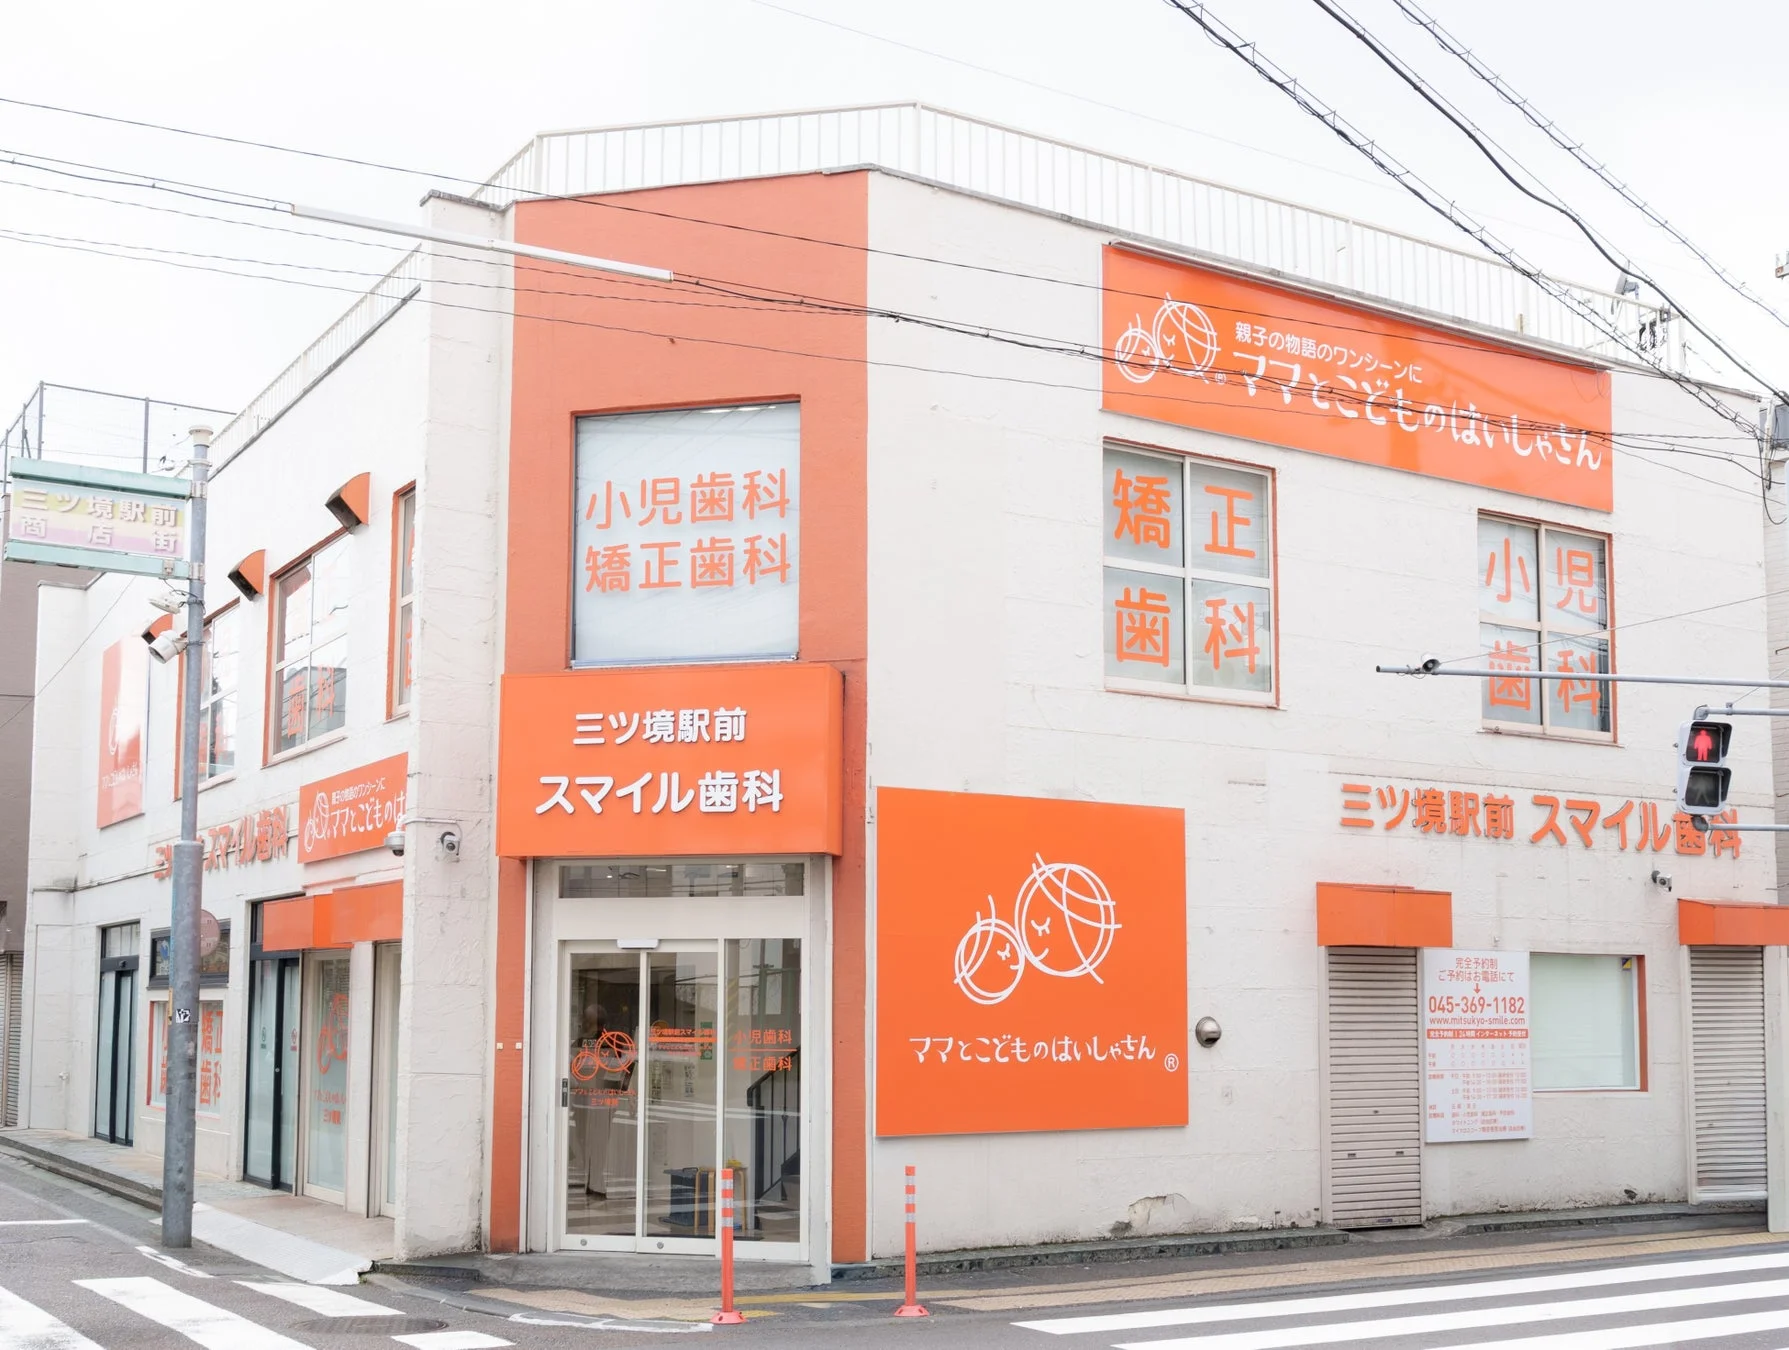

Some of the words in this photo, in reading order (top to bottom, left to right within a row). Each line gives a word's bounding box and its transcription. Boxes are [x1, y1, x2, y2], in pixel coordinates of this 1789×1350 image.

[1234, 319, 1424, 385] 親子の物語のワンシーンに
[1232, 350, 1602, 471] ママとこどものはいしゃさん
[21, 488, 178, 528] 三ツ境駅前
[585, 468, 792, 530] 小児歯科
[1113, 467, 1256, 559] 矯正
[20, 517, 178, 553] 商店街
[585, 532, 792, 594] 矯正歯科
[1484, 537, 1597, 614] 小児
[1114, 586, 1260, 675] 歯科
[1488, 640, 1601, 716] 歯科
[572, 706, 748, 745] 三ツ境駅前
[534, 768, 785, 815] スマイル歯科
[1340, 783, 1515, 840] 三ツ境駅前
[1530, 794, 1742, 859] スマイル歯科
[1438, 970, 1515, 983] ご予約はお電話にて
[1455, 957, 1498, 970] 完全予約制
[1428, 996, 1525, 1014] 045-369-1182
[1428, 1016, 1526, 1028] www.mitsukyo-smile.com
[733, 1029, 792, 1044] 小児歯科
[909, 1034, 1156, 1063] ママとこどものはいしゃさん
